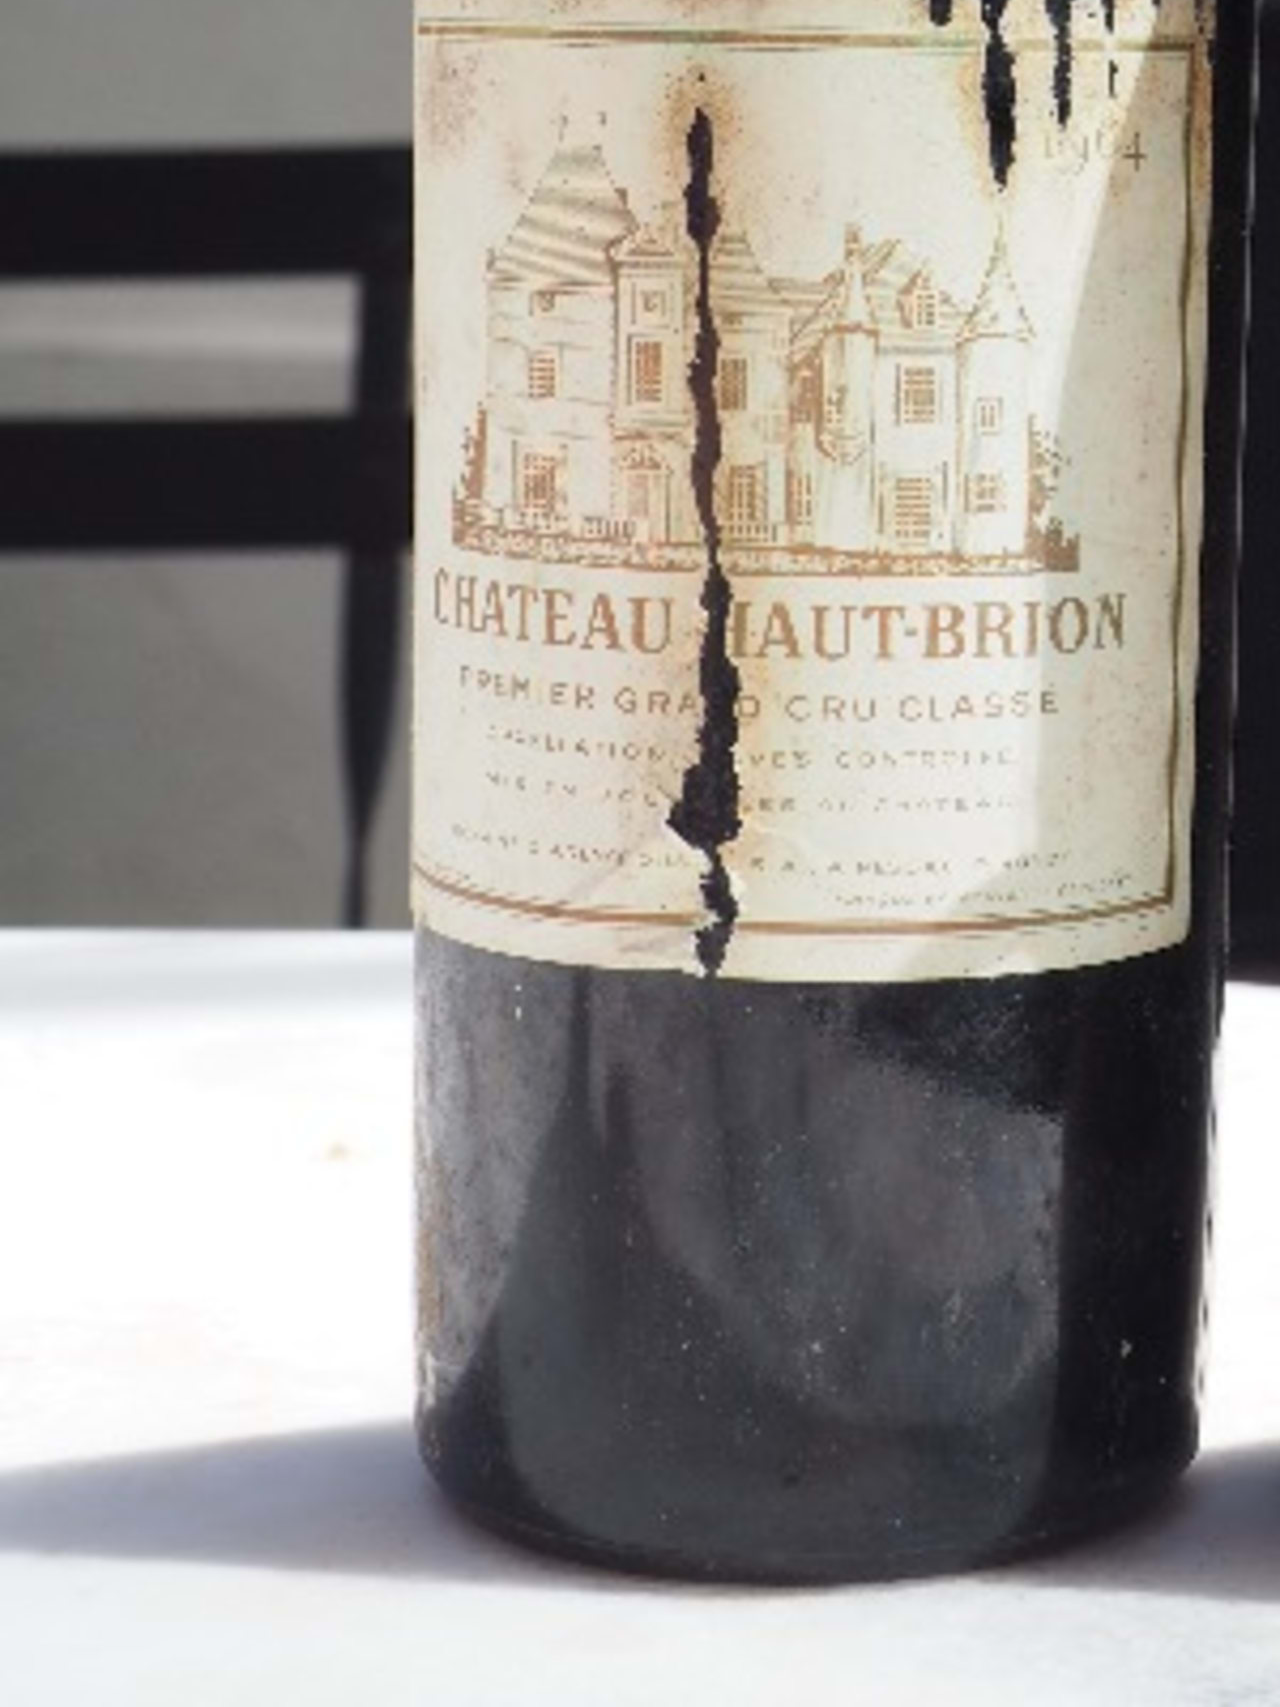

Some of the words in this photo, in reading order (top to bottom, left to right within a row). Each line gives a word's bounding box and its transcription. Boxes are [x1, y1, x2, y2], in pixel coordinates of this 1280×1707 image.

[433, 565, 677, 656] CHATEAU
[459, 664, 597, 710] PREMER
[613, 686, 762, 719] GRAD
[786, 694, 877, 723] CRU
